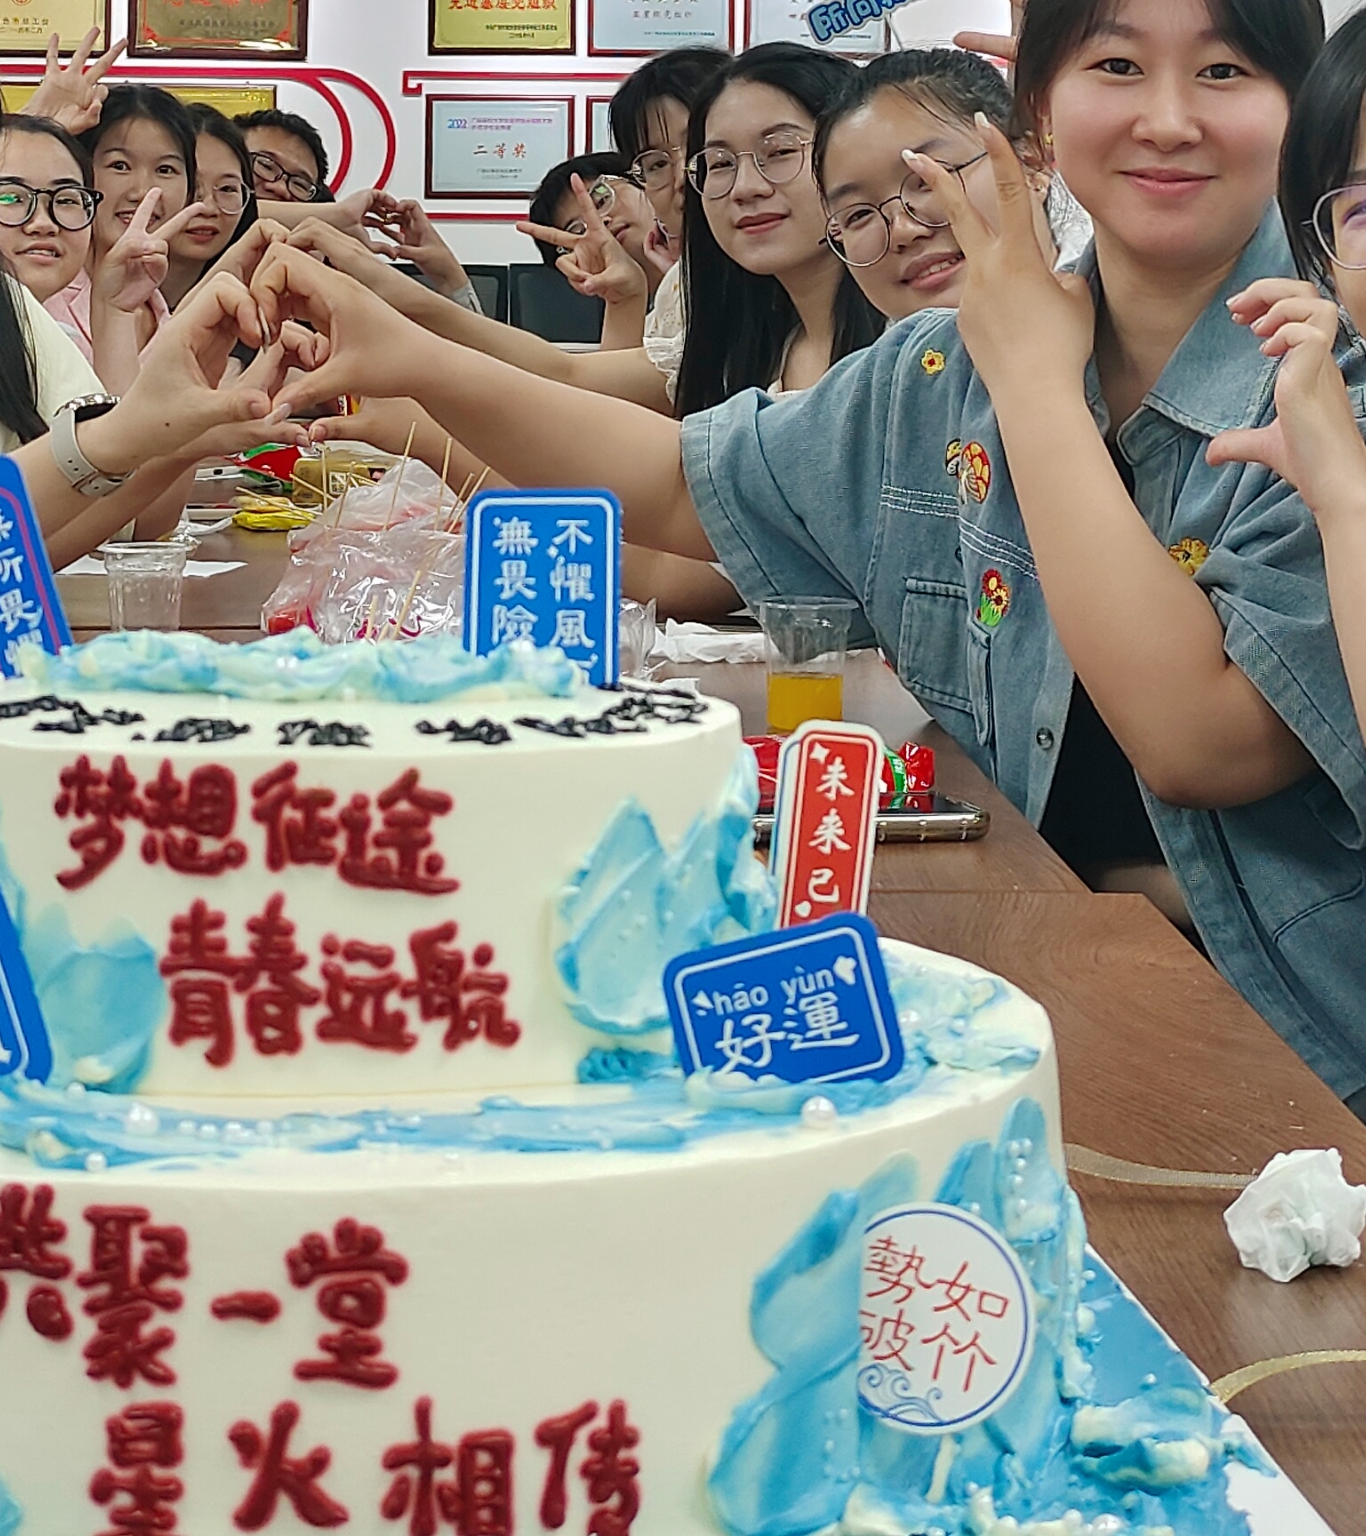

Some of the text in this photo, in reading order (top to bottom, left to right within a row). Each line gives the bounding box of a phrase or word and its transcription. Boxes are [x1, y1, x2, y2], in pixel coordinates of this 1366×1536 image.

[473, 142, 527, 159] 二等奖
[54, 754, 460, 896] 梦想征途
[159, 891, 521, 1068] 青春远航
[714, 994, 860, 1074] 好運
[864, 1235, 1010, 1322] 勢如
[88, 1395, 641, 1536] 星火相传
